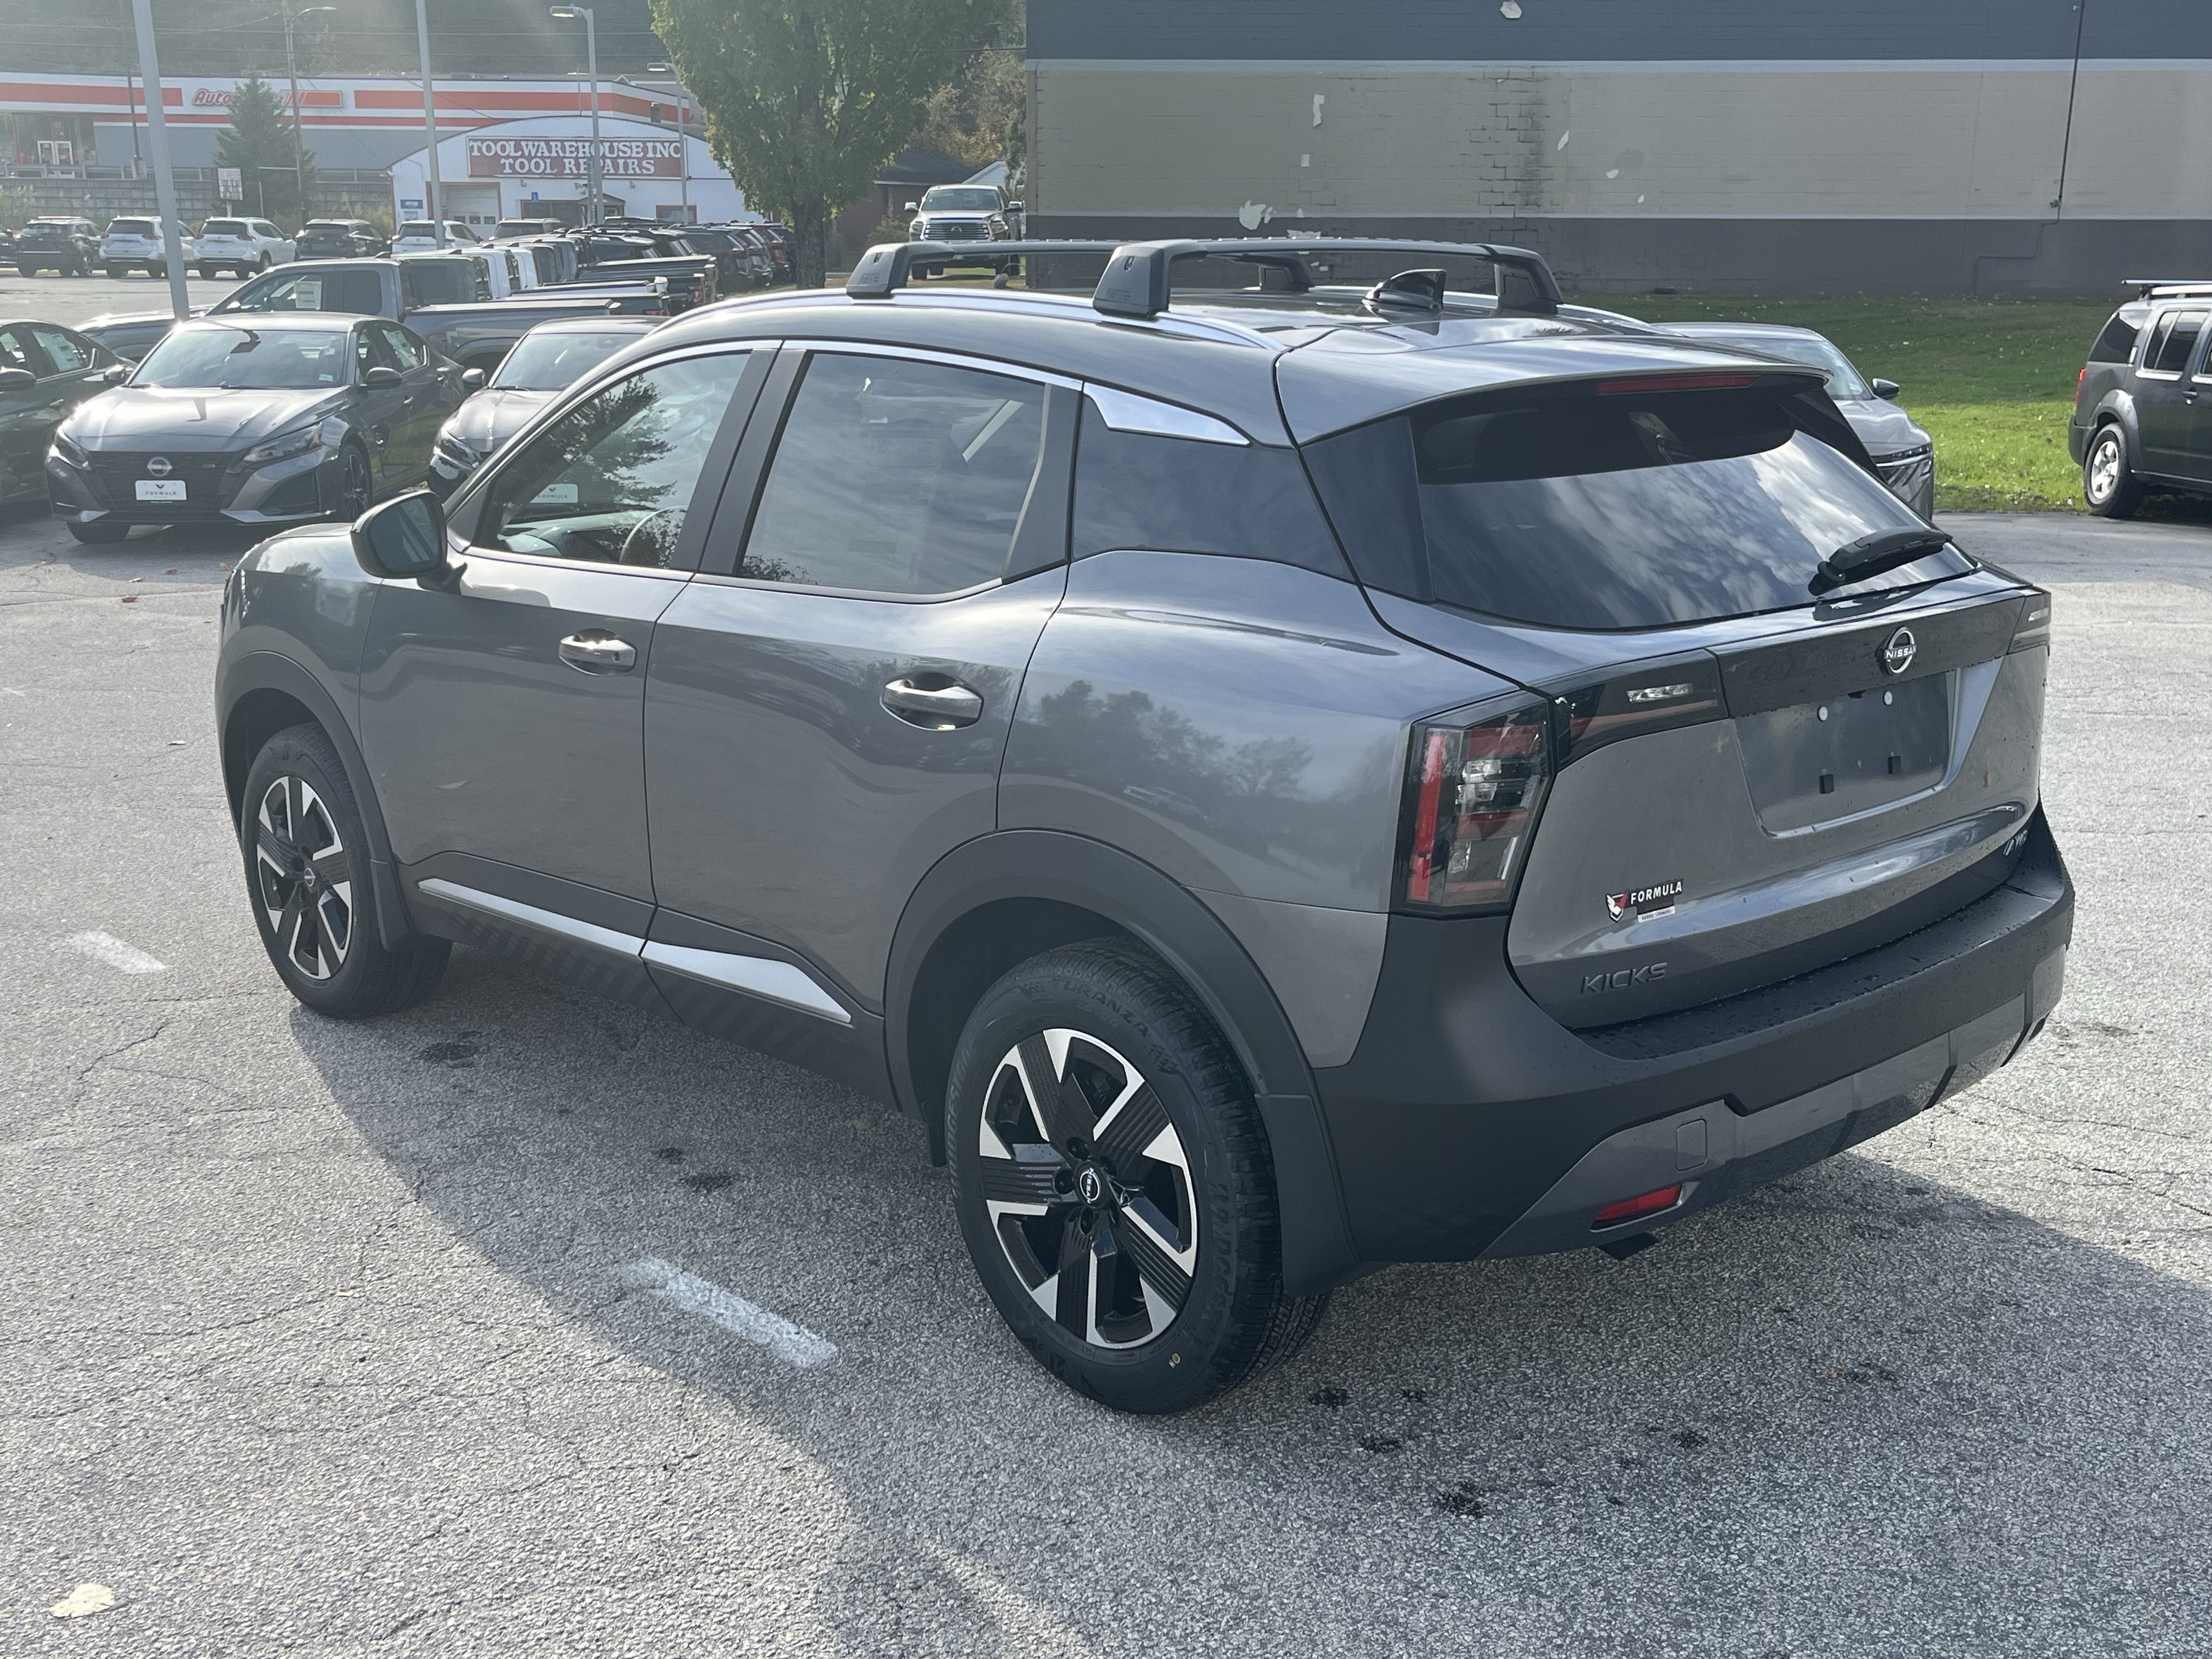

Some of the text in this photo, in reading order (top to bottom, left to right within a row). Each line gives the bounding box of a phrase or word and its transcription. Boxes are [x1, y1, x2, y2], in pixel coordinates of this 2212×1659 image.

[646, 142, 680, 158] INC
[500, 158, 655, 174] TOOL REAIRS
[1886, 646, 1916, 659] NISSAN
[1630, 881, 1682, 905] FORMULA
[1580, 962, 1667, 994] KICKS
[1086, 1167, 1094, 1204] NISSAN
